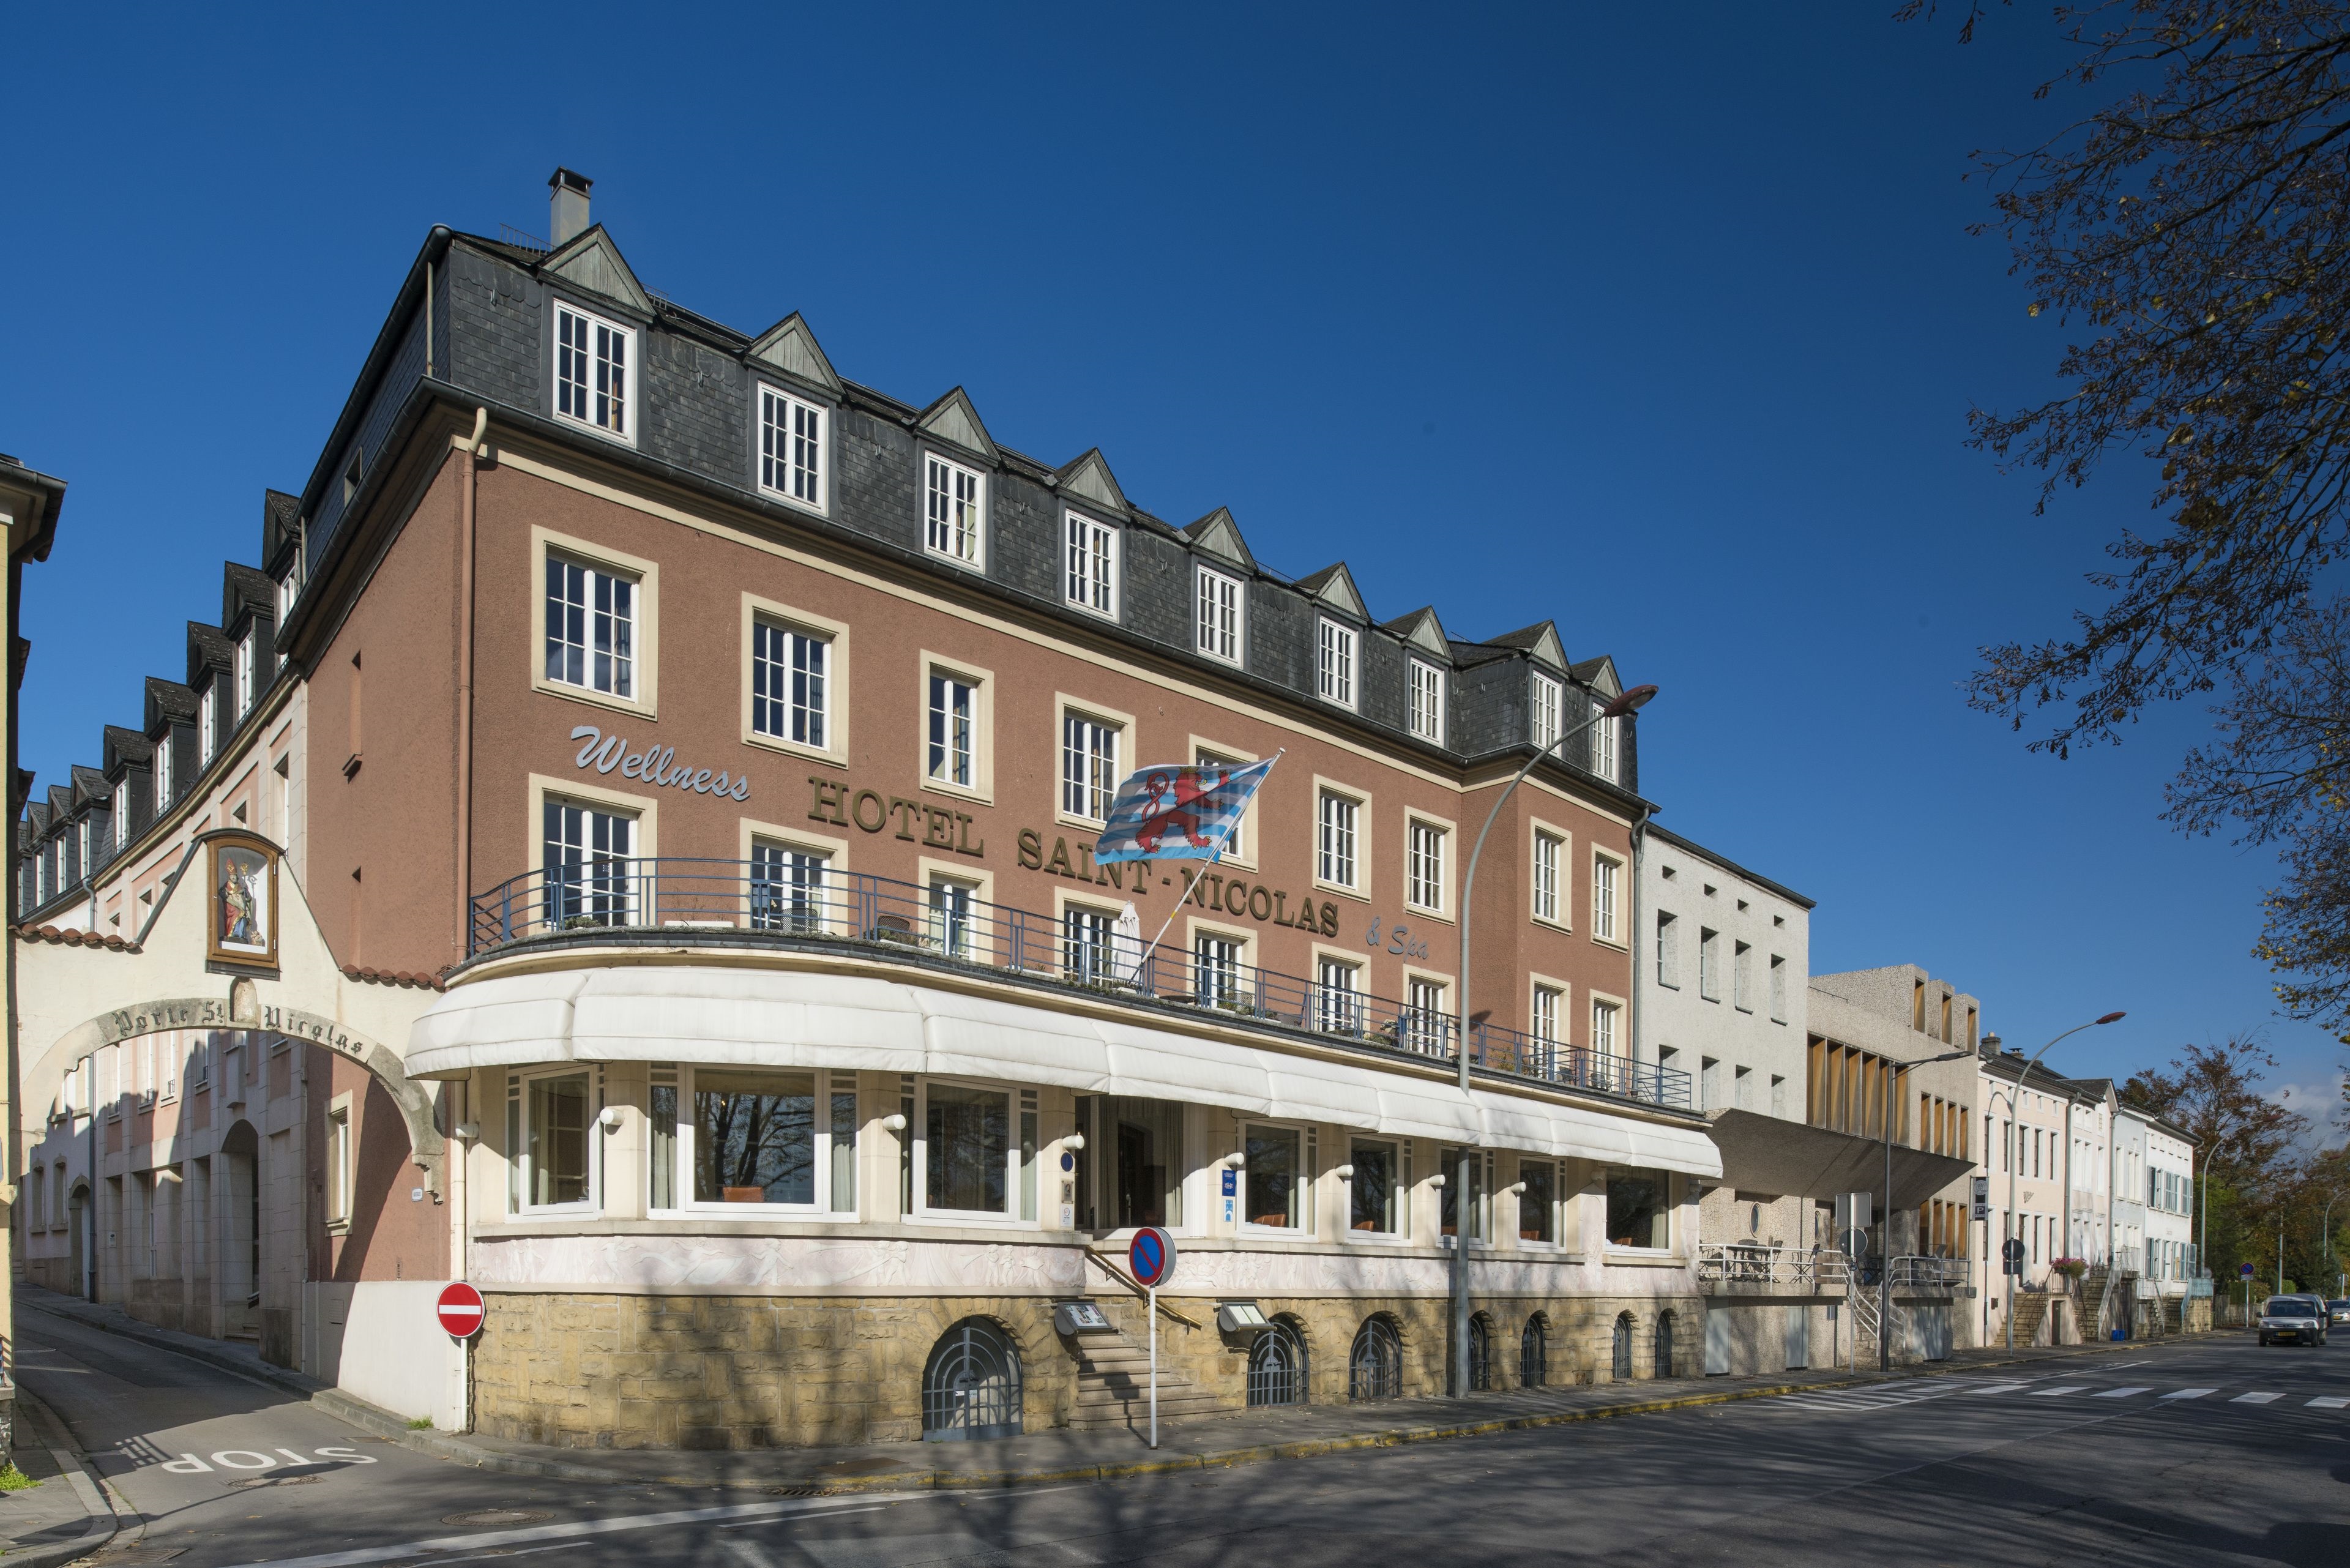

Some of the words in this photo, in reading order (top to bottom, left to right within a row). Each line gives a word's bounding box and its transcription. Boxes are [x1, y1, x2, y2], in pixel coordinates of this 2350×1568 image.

[570, 725, 750, 801] Wellness
[808, 775, 984, 858] HOTEL
[1018, 828, 1152, 895] SAINT
[1180, 867, 1339, 938] NICOLAS
[1365, 916, 1381, 946] &
[1387, 925, 1429, 963] Spa
[112, 1010, 188, 1037] Porte
[264, 1006, 363, 1053] Nicolas
[161, 1447, 378, 1473] STOP
